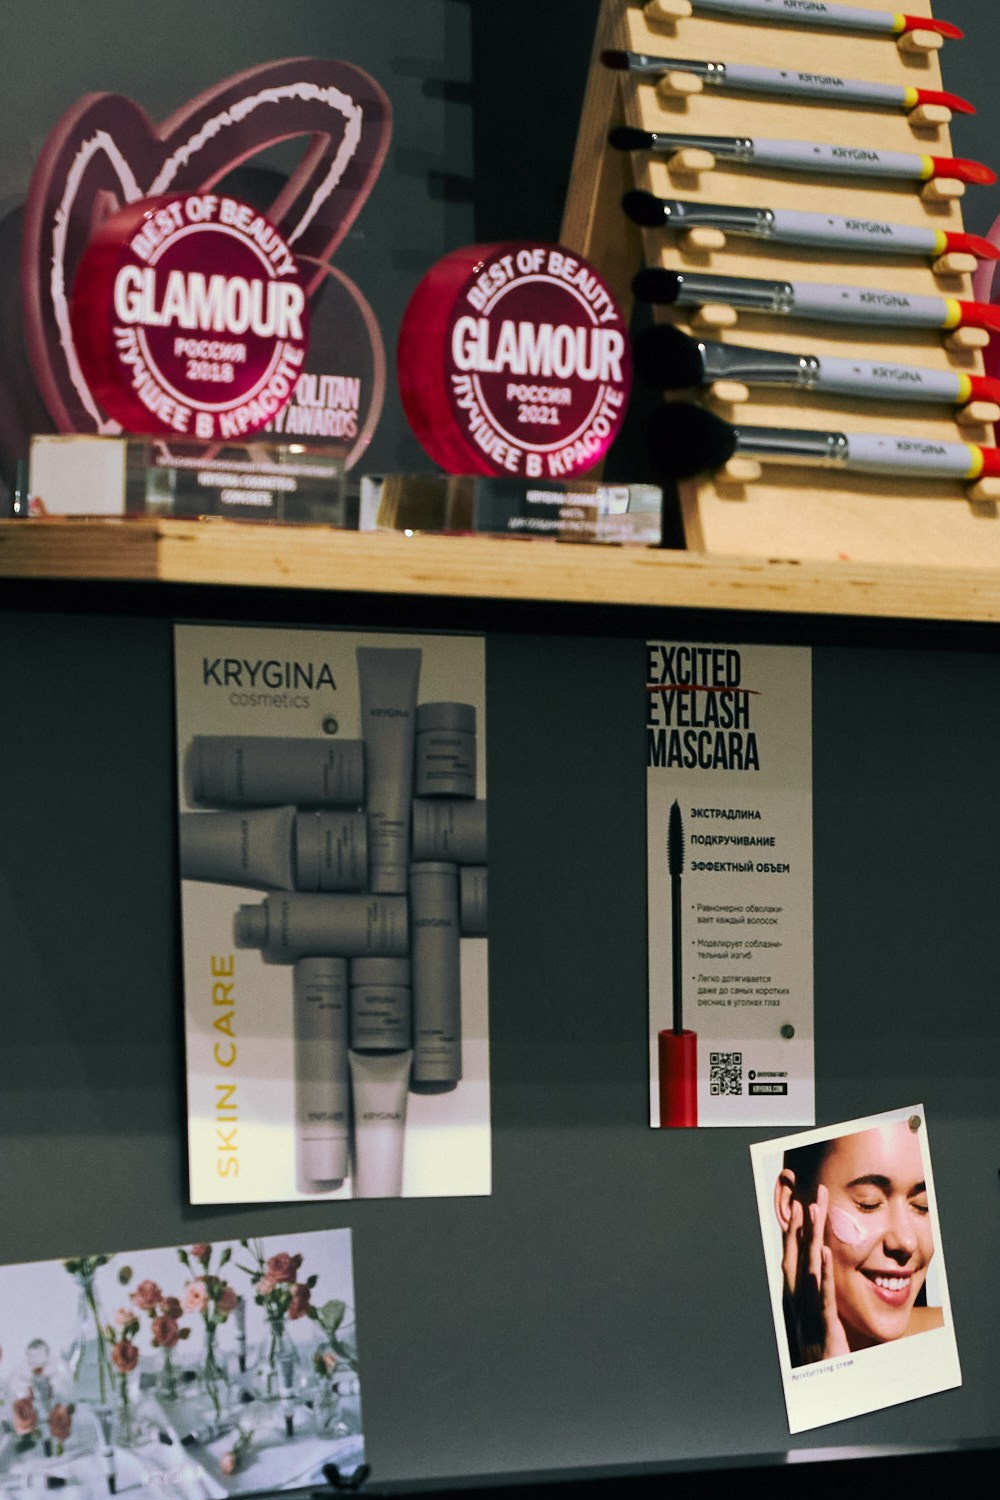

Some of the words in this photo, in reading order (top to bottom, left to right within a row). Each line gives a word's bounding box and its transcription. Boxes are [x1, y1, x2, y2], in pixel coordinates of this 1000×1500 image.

[831, 147, 879, 162] KRYGINA
[130, 201, 184, 261] BEST
[185, 195, 219, 222] OF
[220, 198, 298, 276] BEAUTY
[845, 220, 892, 235] KRYGINA
[114, 265, 305, 340] GLAMOUR
[466, 255, 514, 311] BEST
[516, 249, 546, 274] OF
[548, 251, 618, 323] BEAUTY
[860, 293, 910, 308] KRYGINA
[174, 338, 246, 363] РОССИЯ
[452, 316, 624, 382] GLAMOUR
[113, 327, 192, 432] ЛУЧШЕЕ
[196, 413, 213, 438] В
[220, 342, 304, 439] КРАСОТЕ
[872, 367, 922, 382] KRYGINA
[507, 384, 572, 406] РОССИЯ
[451, 374, 522, 472] ЛУЧШЕЕ
[526, 453, 542, 478] В
[547, 386, 624, 477] КРАСОТЕ
[202, 657, 337, 691] KRYGINA
[647, 646, 742, 687] EXCITED
[229, 691, 311, 709] cosmetics
[647, 688, 749, 729] EYELASH
[647, 728, 760, 771] MASCARA
[690, 808, 761, 821] ЭКСТРАДЛИНА
[691, 834, 776, 847] ПОДКРУЧИВАНИЕ
[691, 860, 754, 873] ЭФФЕКТНЫЙ
[756, 863, 790, 874] ОБЪЕМ
[210, 954, 237, 1068] CARE
[215, 1084, 240, 1178] SKIN
